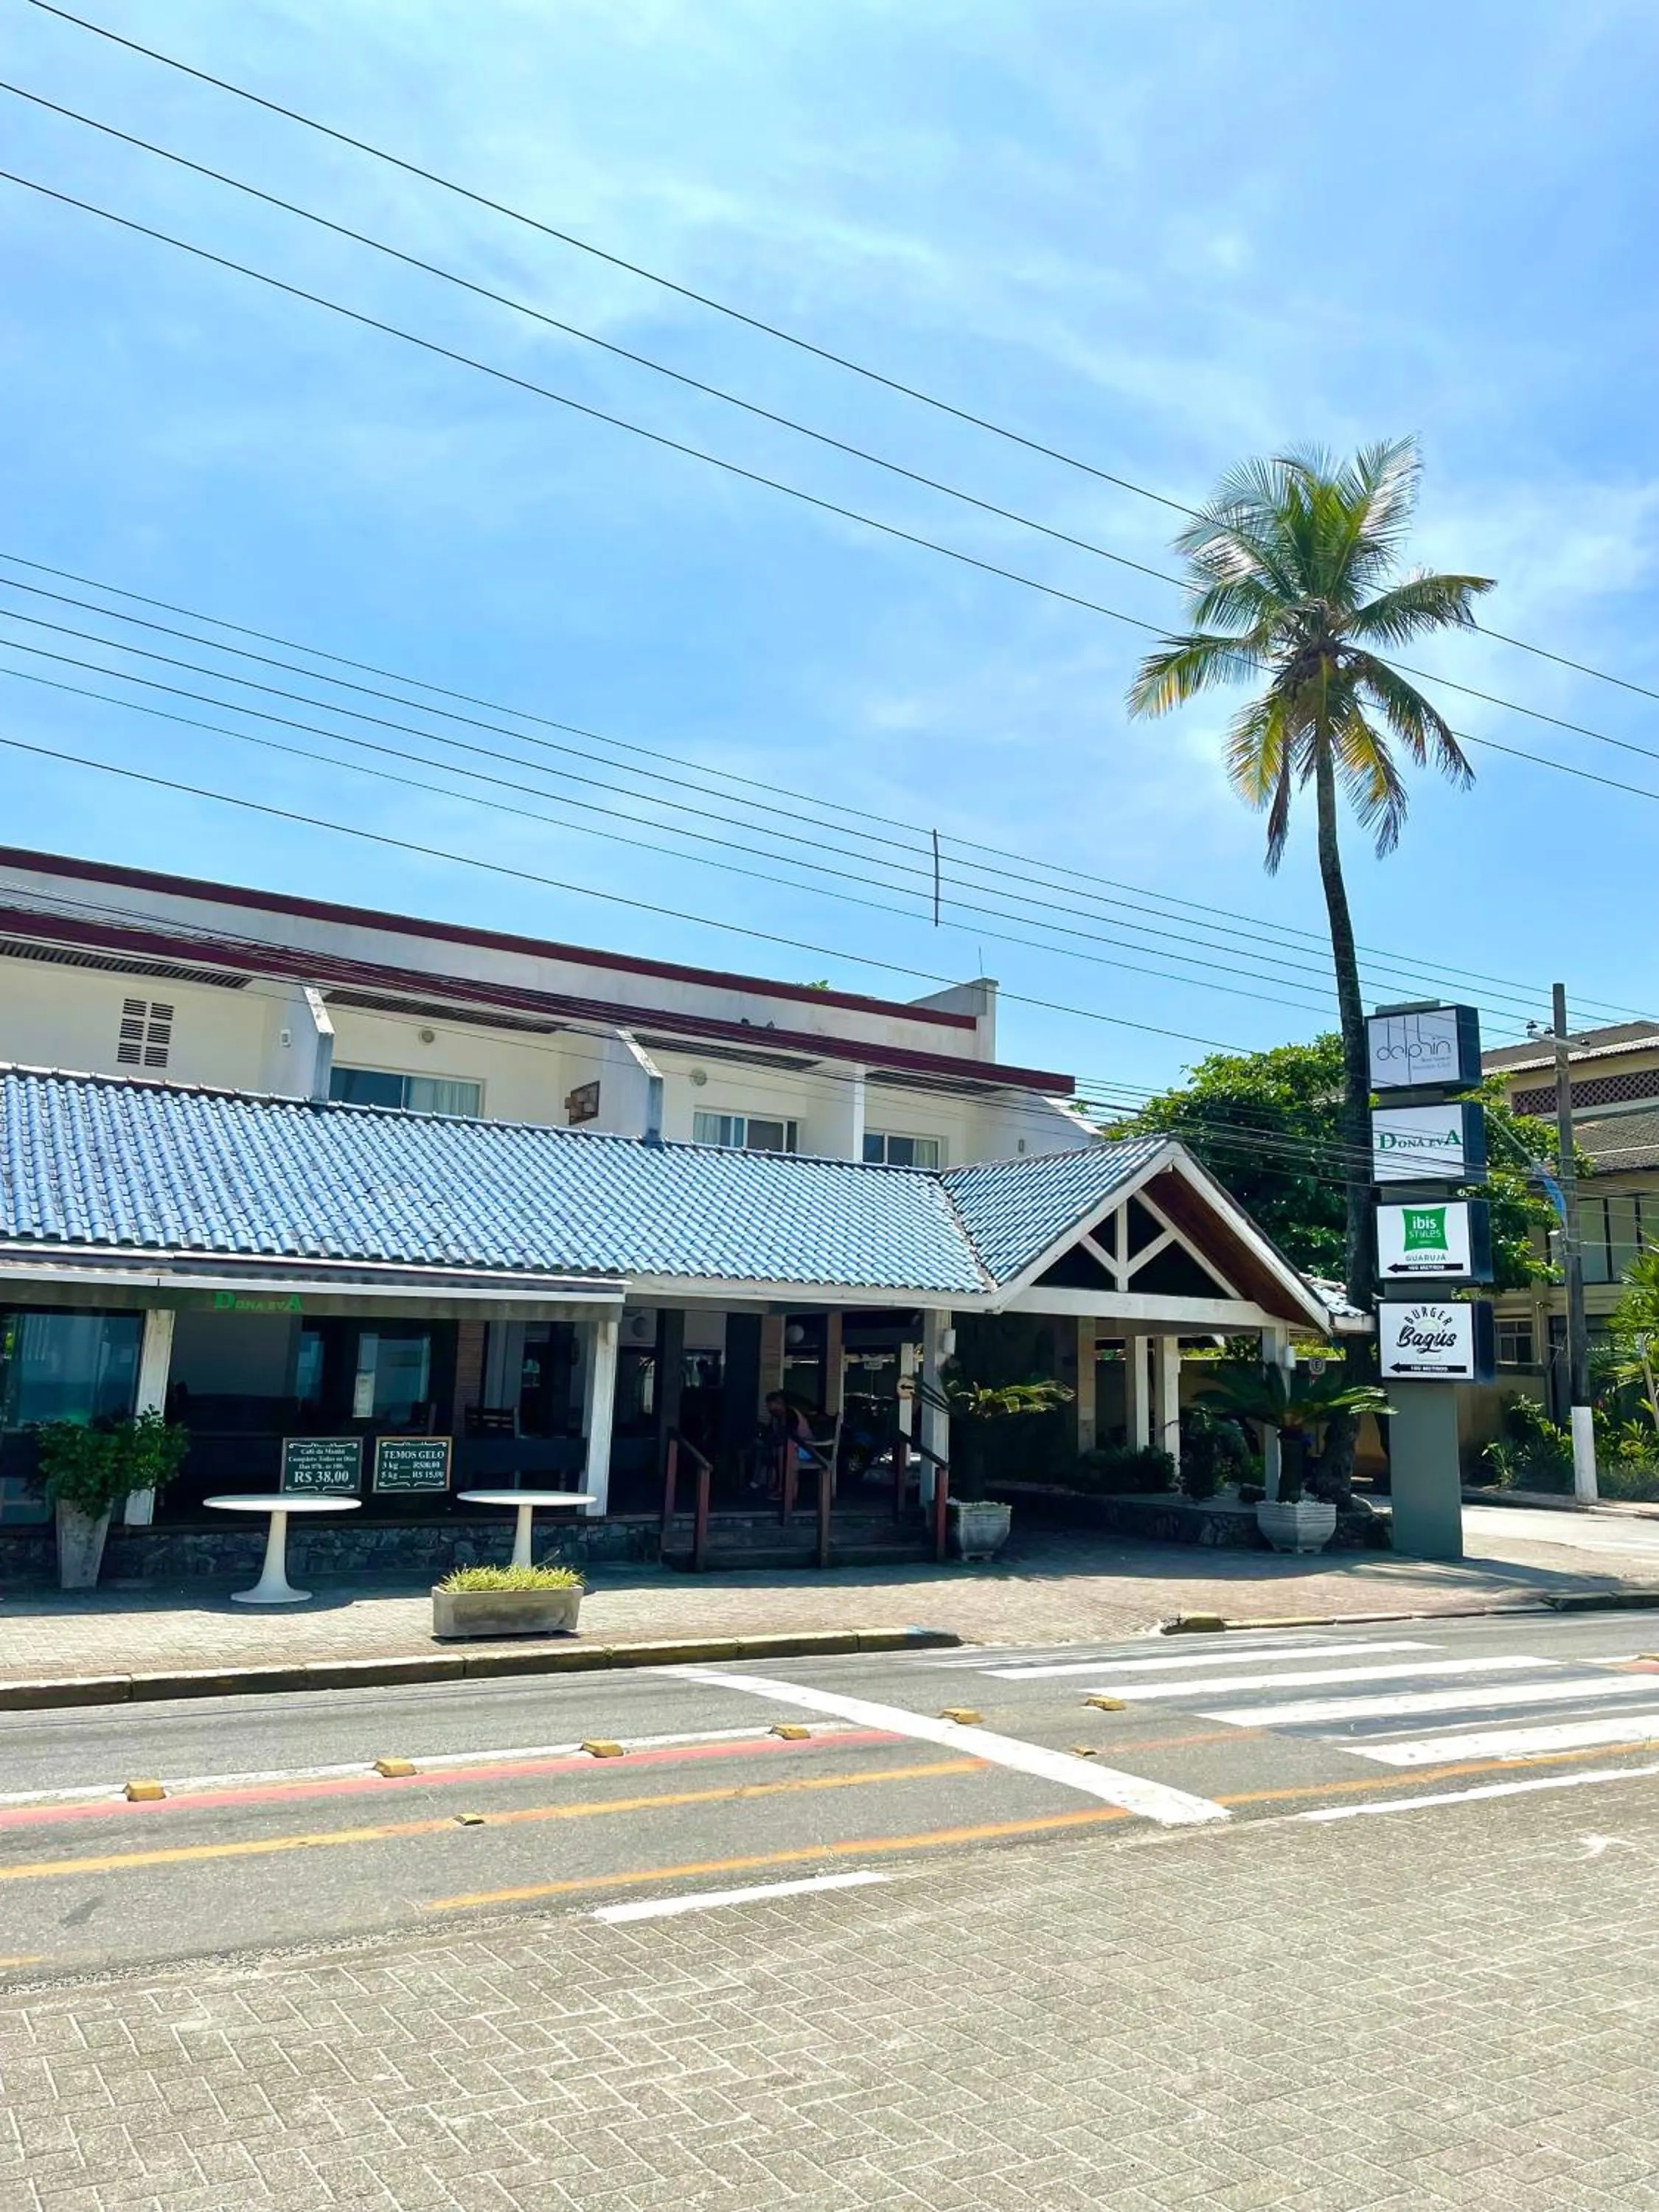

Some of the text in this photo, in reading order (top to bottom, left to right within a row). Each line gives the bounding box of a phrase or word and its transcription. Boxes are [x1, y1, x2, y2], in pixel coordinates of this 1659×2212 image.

[1412, 1216, 1437, 1229] ibis
[1409, 1228, 1442, 1239] STYLES
[1404, 1306, 1453, 1326] BURGER
[383, 1450, 445, 1459] TEMOS GELO
